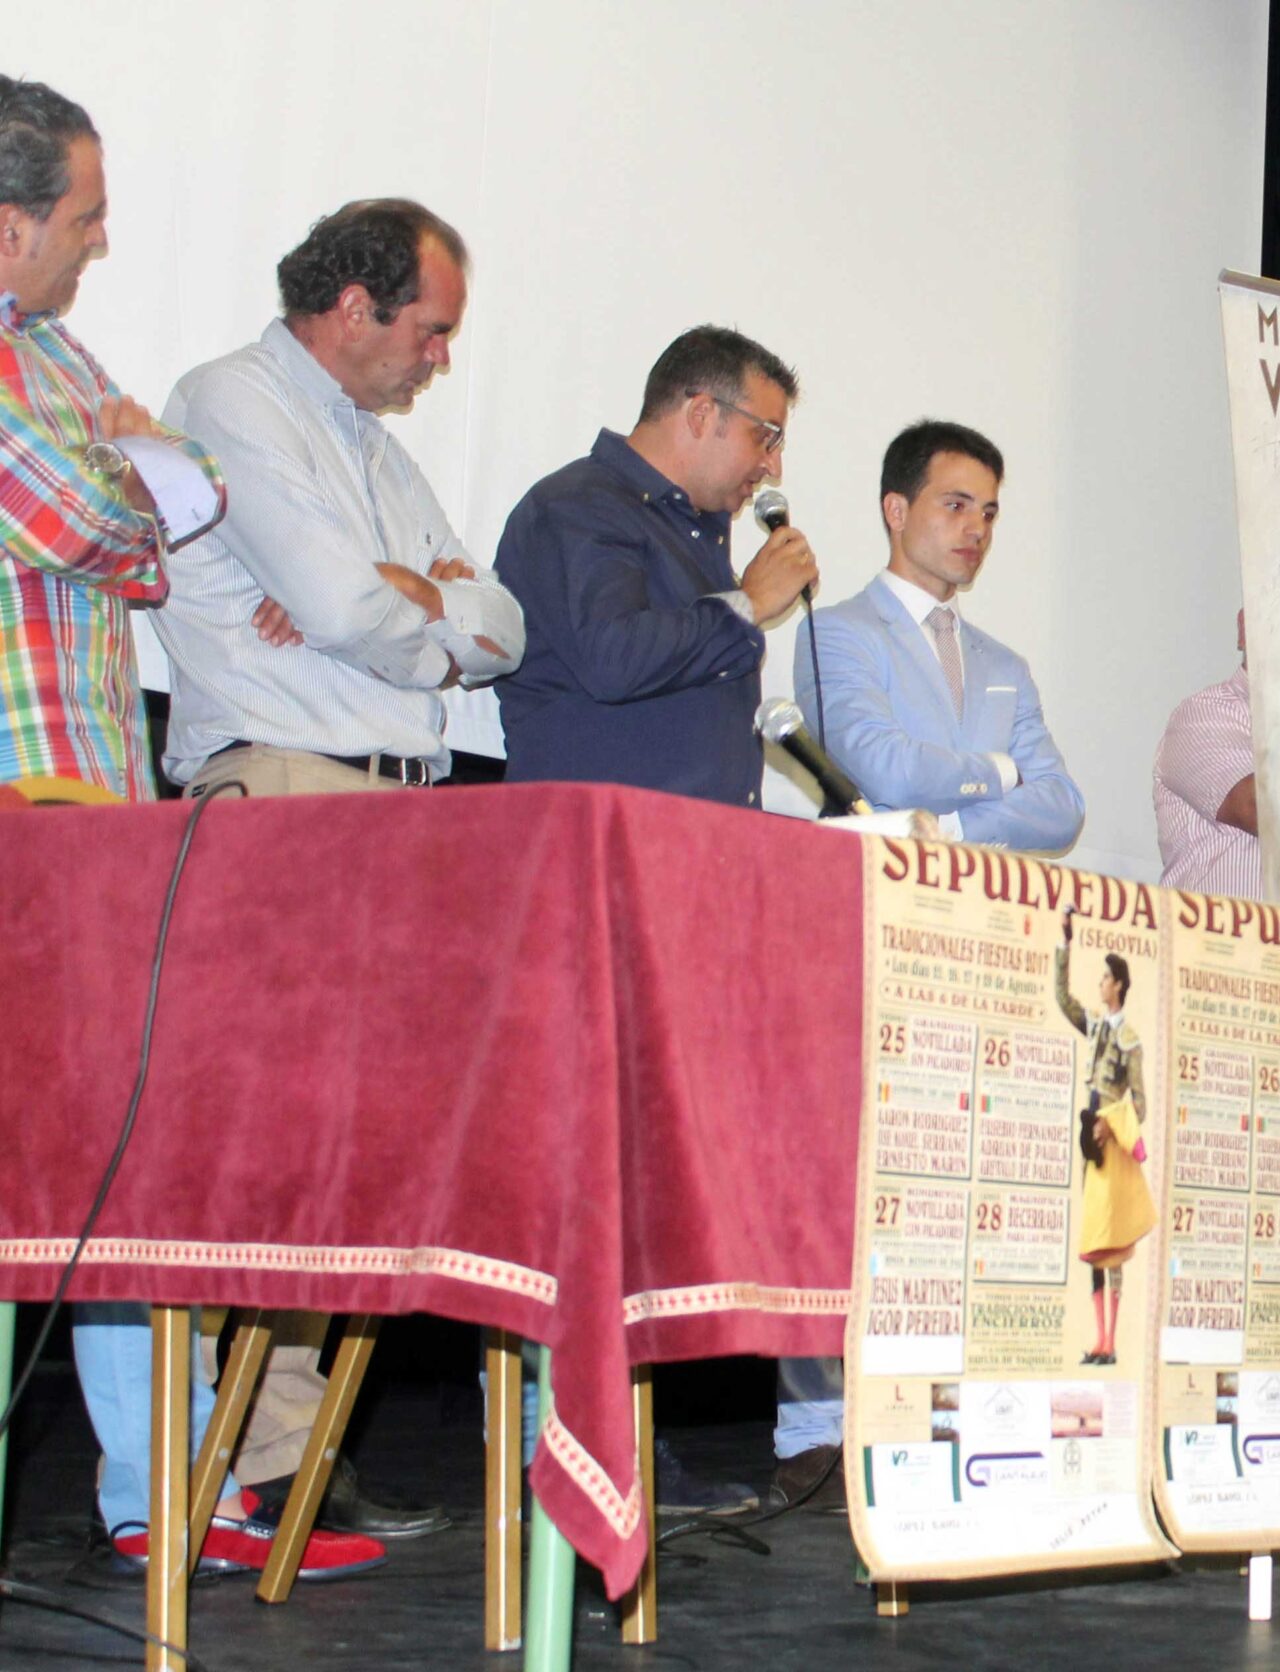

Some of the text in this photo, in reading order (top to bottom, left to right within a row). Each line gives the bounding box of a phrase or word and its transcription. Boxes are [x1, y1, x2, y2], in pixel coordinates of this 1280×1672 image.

[881, 924, 974, 963] TRADICIONALES
[978, 940, 1022, 973] FIESTAS
[1079, 928, 1158, 958] (SEGOVIA)
[880, 1024, 905, 1053] 25
[985, 1039, 1011, 1067] 26
[1178, 1055, 1199, 1081] 25
[1259, 1066, 1280, 1092] 26
[875, 1197, 900, 1225] 27
[976, 1204, 1002, 1231] 28
[1173, 1206, 1195, 1232] 27
[1254, 1213, 1275, 1238] 28
